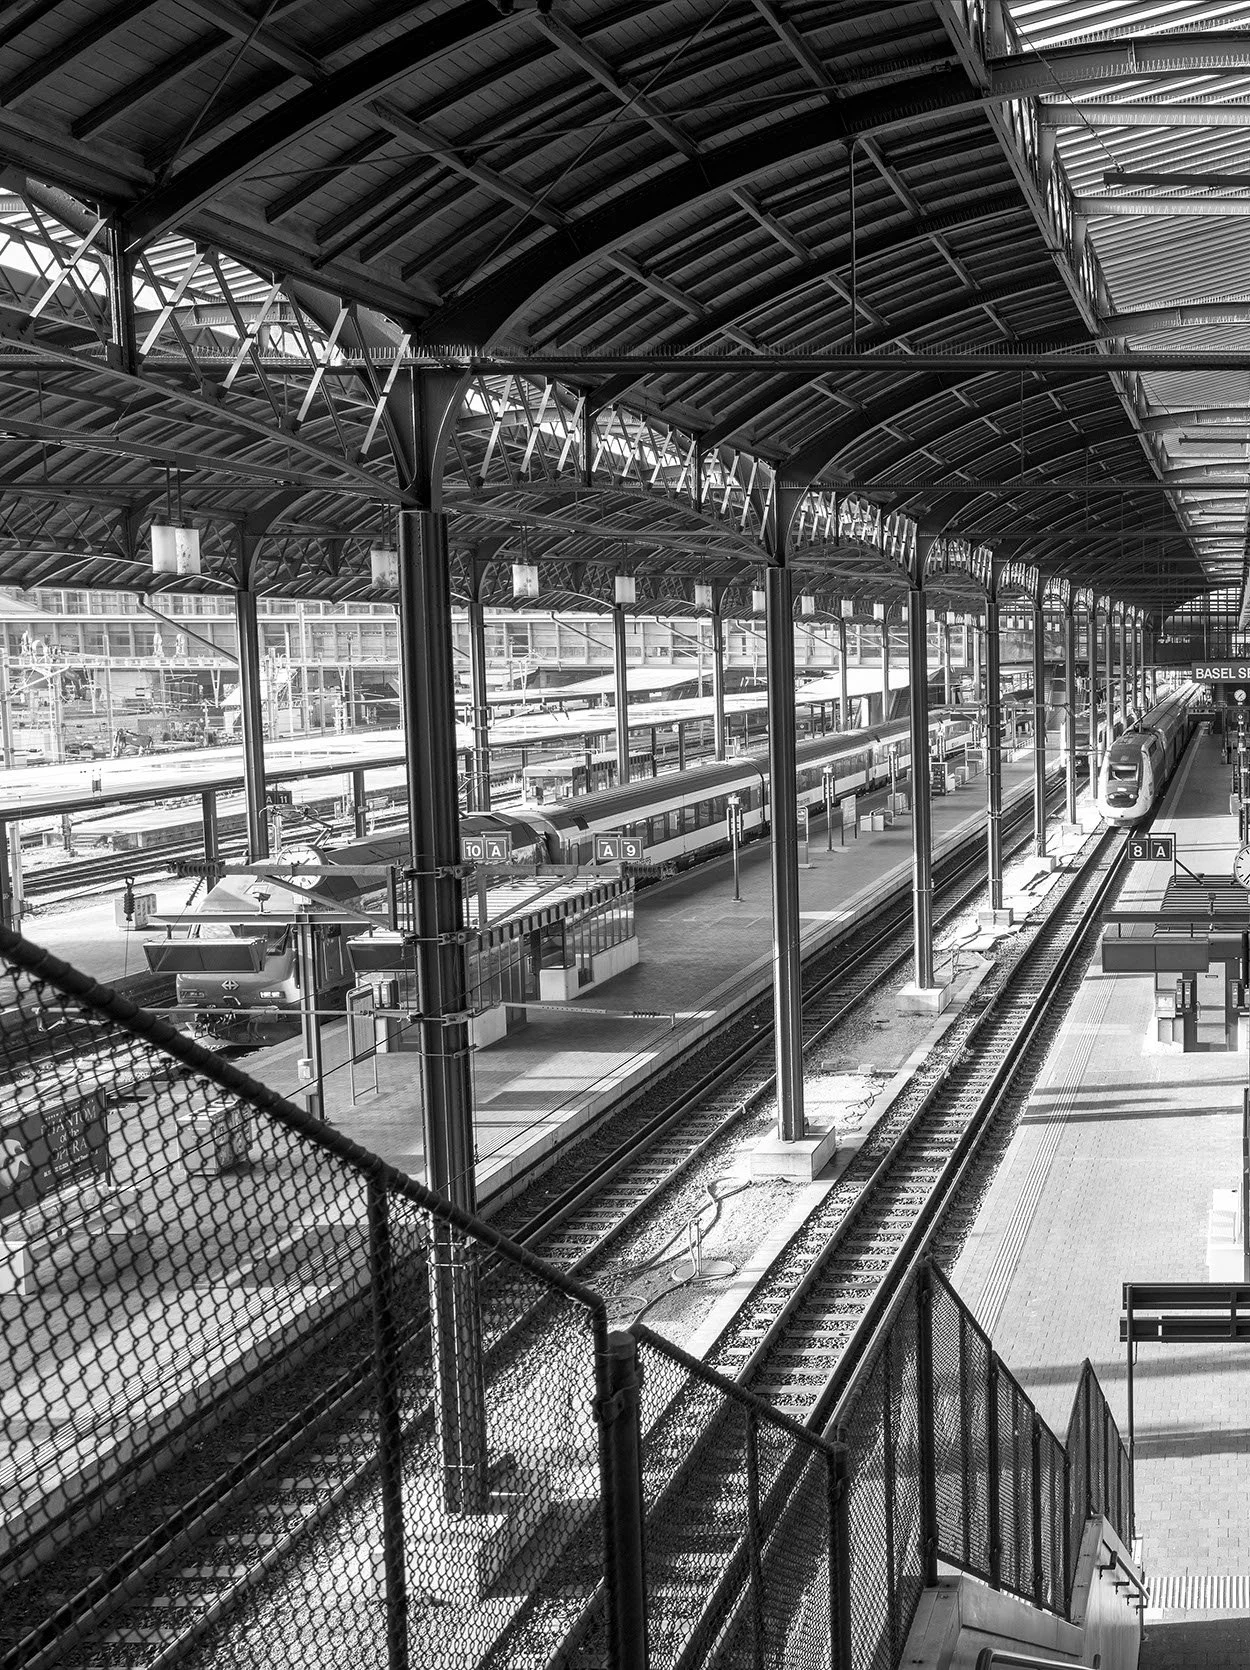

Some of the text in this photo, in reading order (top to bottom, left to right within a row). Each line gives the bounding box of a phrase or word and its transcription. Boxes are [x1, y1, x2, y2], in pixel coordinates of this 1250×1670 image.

[1195, 667, 1236, 679] BASEL
[279, 795, 288, 804] 11
[466, 845, 502, 857] 10 A
[603, 845, 636, 857] A 9
[1133, 845, 1166, 857] 8 A
